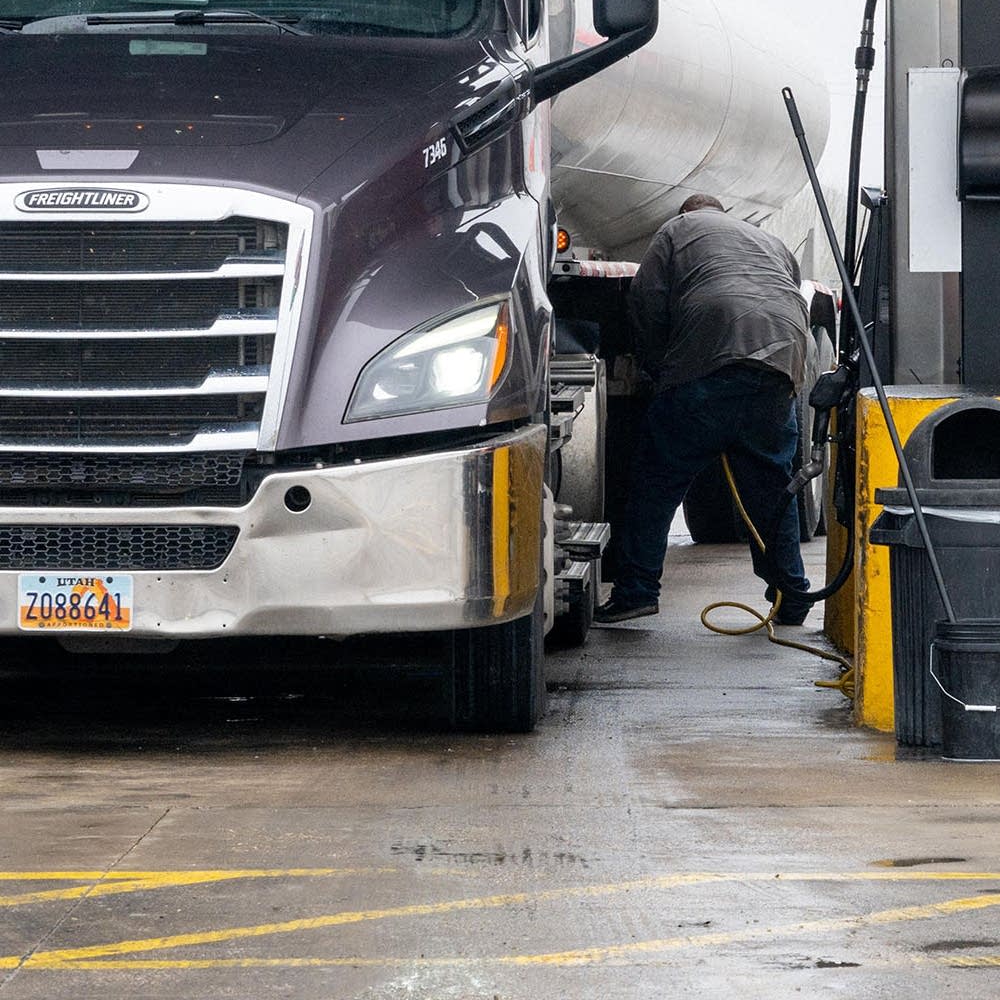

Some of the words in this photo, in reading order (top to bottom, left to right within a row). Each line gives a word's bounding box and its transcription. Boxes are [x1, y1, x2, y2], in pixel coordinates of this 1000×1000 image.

[422, 136, 447, 168] 7346
[28, 191, 135, 205] FREIGHTLINER
[56, 577, 95, 586] UTAH
[26, 592, 122, 620] Z088641
